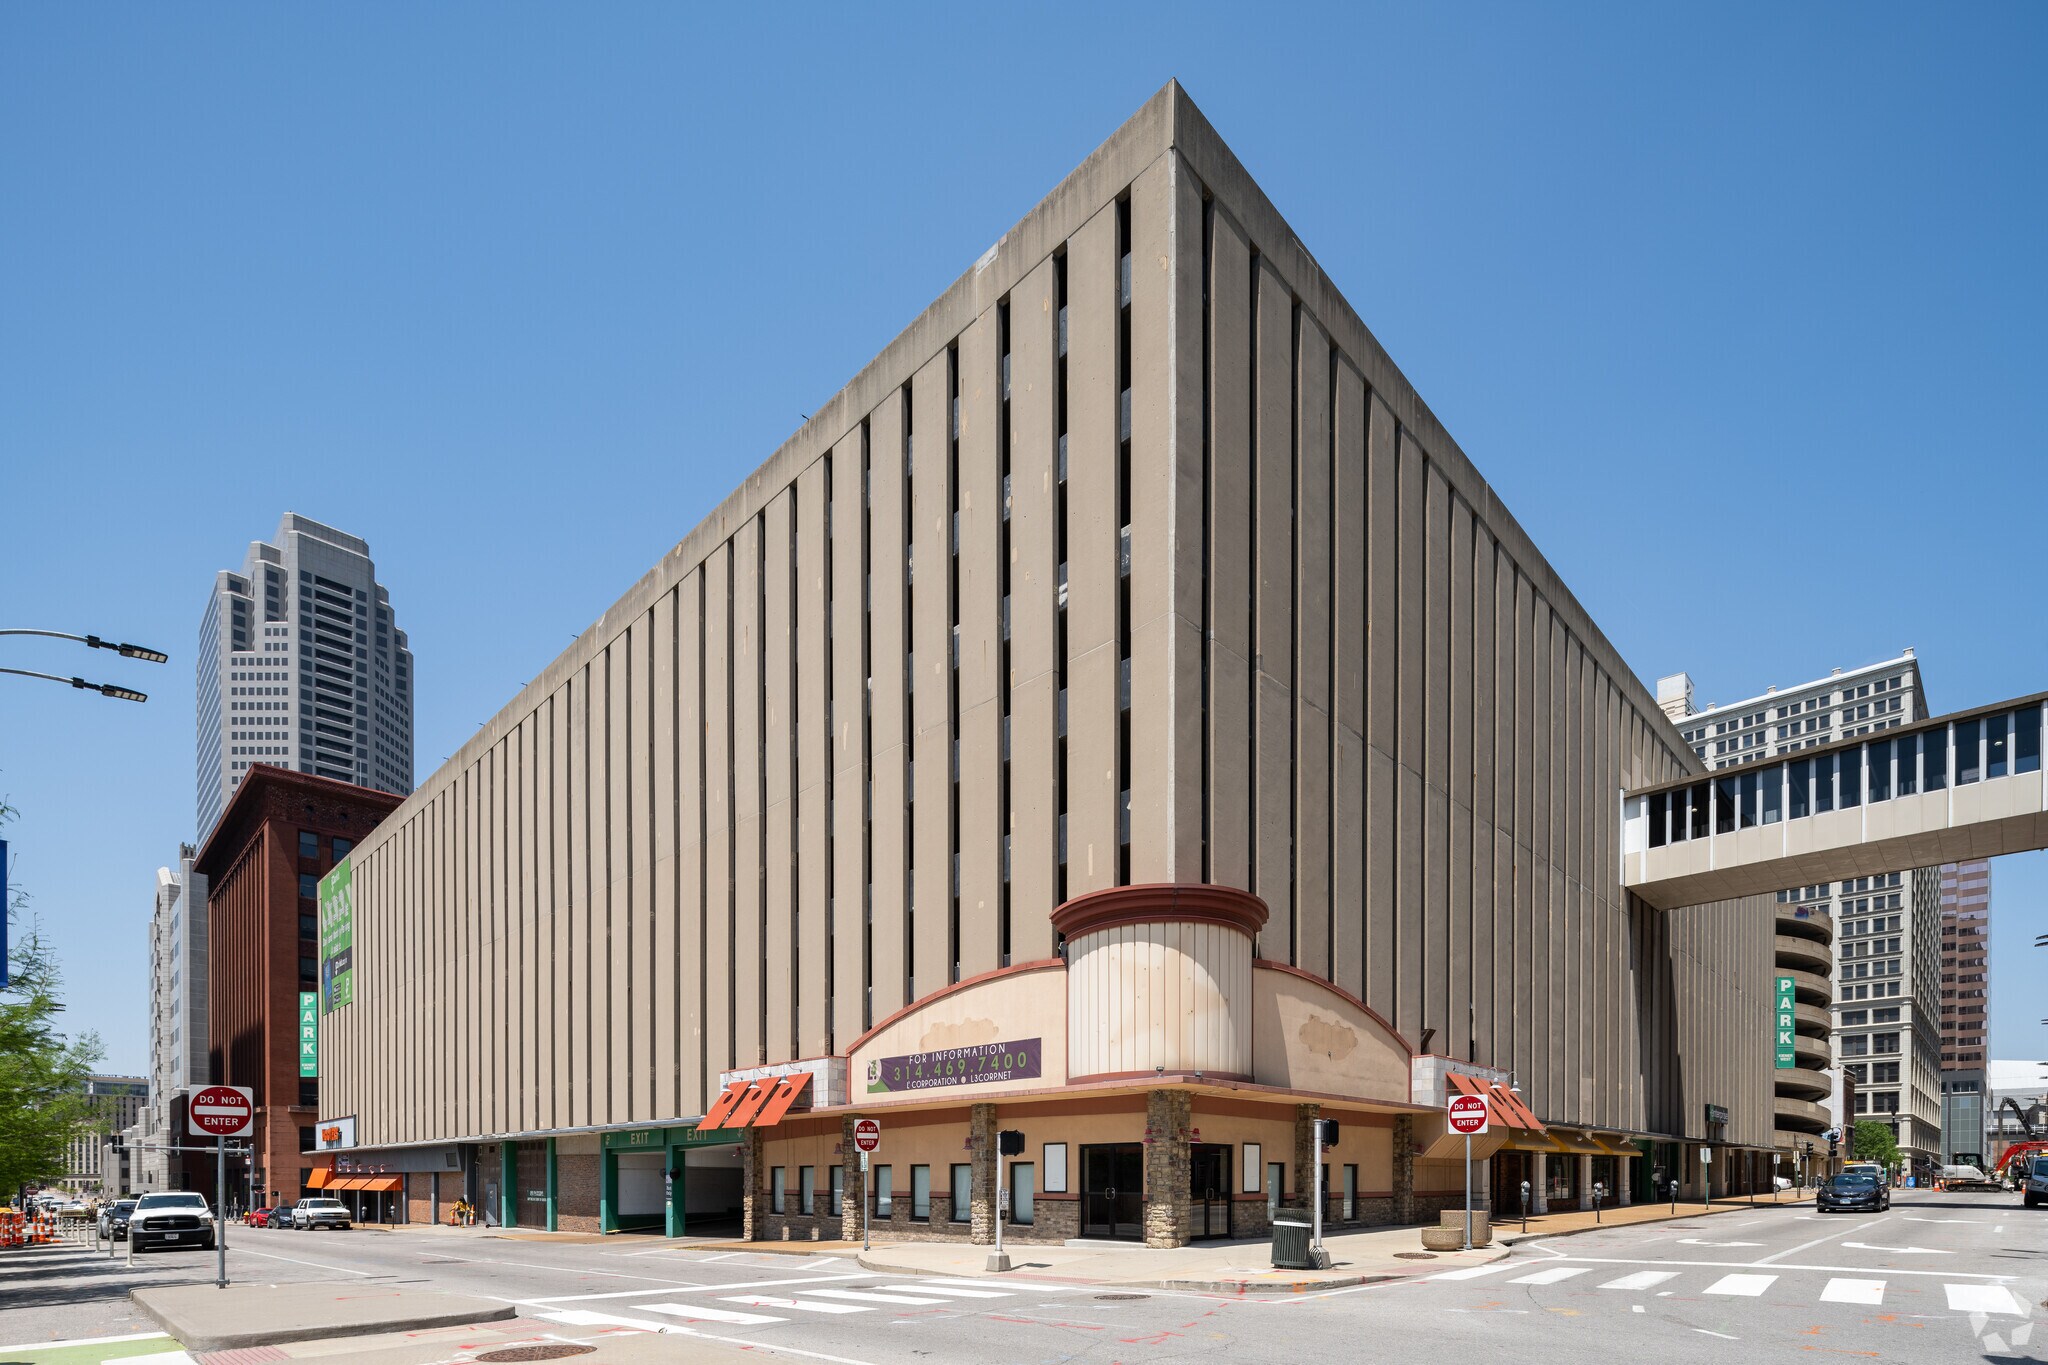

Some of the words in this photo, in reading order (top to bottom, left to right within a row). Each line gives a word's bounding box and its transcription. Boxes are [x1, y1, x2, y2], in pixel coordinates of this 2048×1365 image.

[1780, 979, 1792, 1044] PARK
[303, 994, 315, 1055] PARK
[909, 1053, 927, 1065] FOR
[932, 1043, 1006, 1061] INFORMATION
[911, 1077, 958, 1089] CORPORATION
[200, 1095, 215, 1104] DO
[221, 1096, 243, 1105] NOT
[1467, 1102, 1482, 1110] NOT
[204, 1117, 239, 1126] ENTER
[1456, 1119, 1479, 1127] ENTER
[630, 1132, 650, 1145] EXIT
